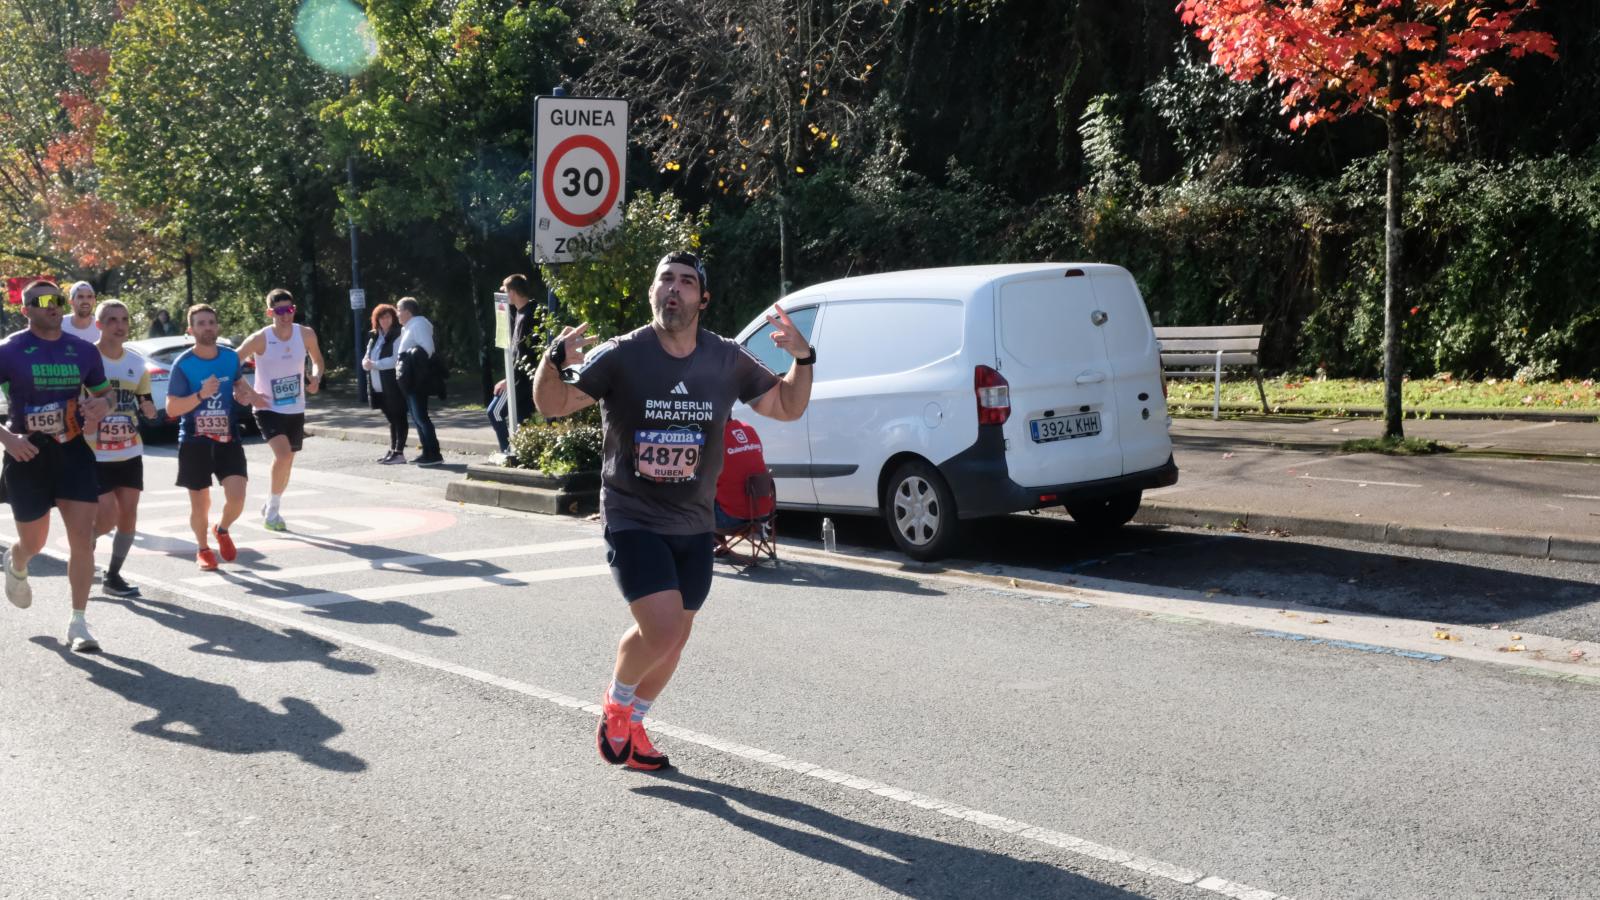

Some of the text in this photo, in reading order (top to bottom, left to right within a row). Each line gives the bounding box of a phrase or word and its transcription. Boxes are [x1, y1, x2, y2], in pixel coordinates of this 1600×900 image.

[550, 109, 615, 126] GUNEA
[562, 167, 603, 197] 30
[554, 237, 599, 254] ZON
[32, 363, 81, 376] BEHOBIA
[645, 399, 713, 411] BMW BERLIN
[197, 417, 228, 428] 3333
[645, 409, 713, 421] MARATHON
[1041, 416, 1098, 438] 3924 KHH
[639, 446, 698, 467] 4879
[655, 468, 684, 477] RUBEN
